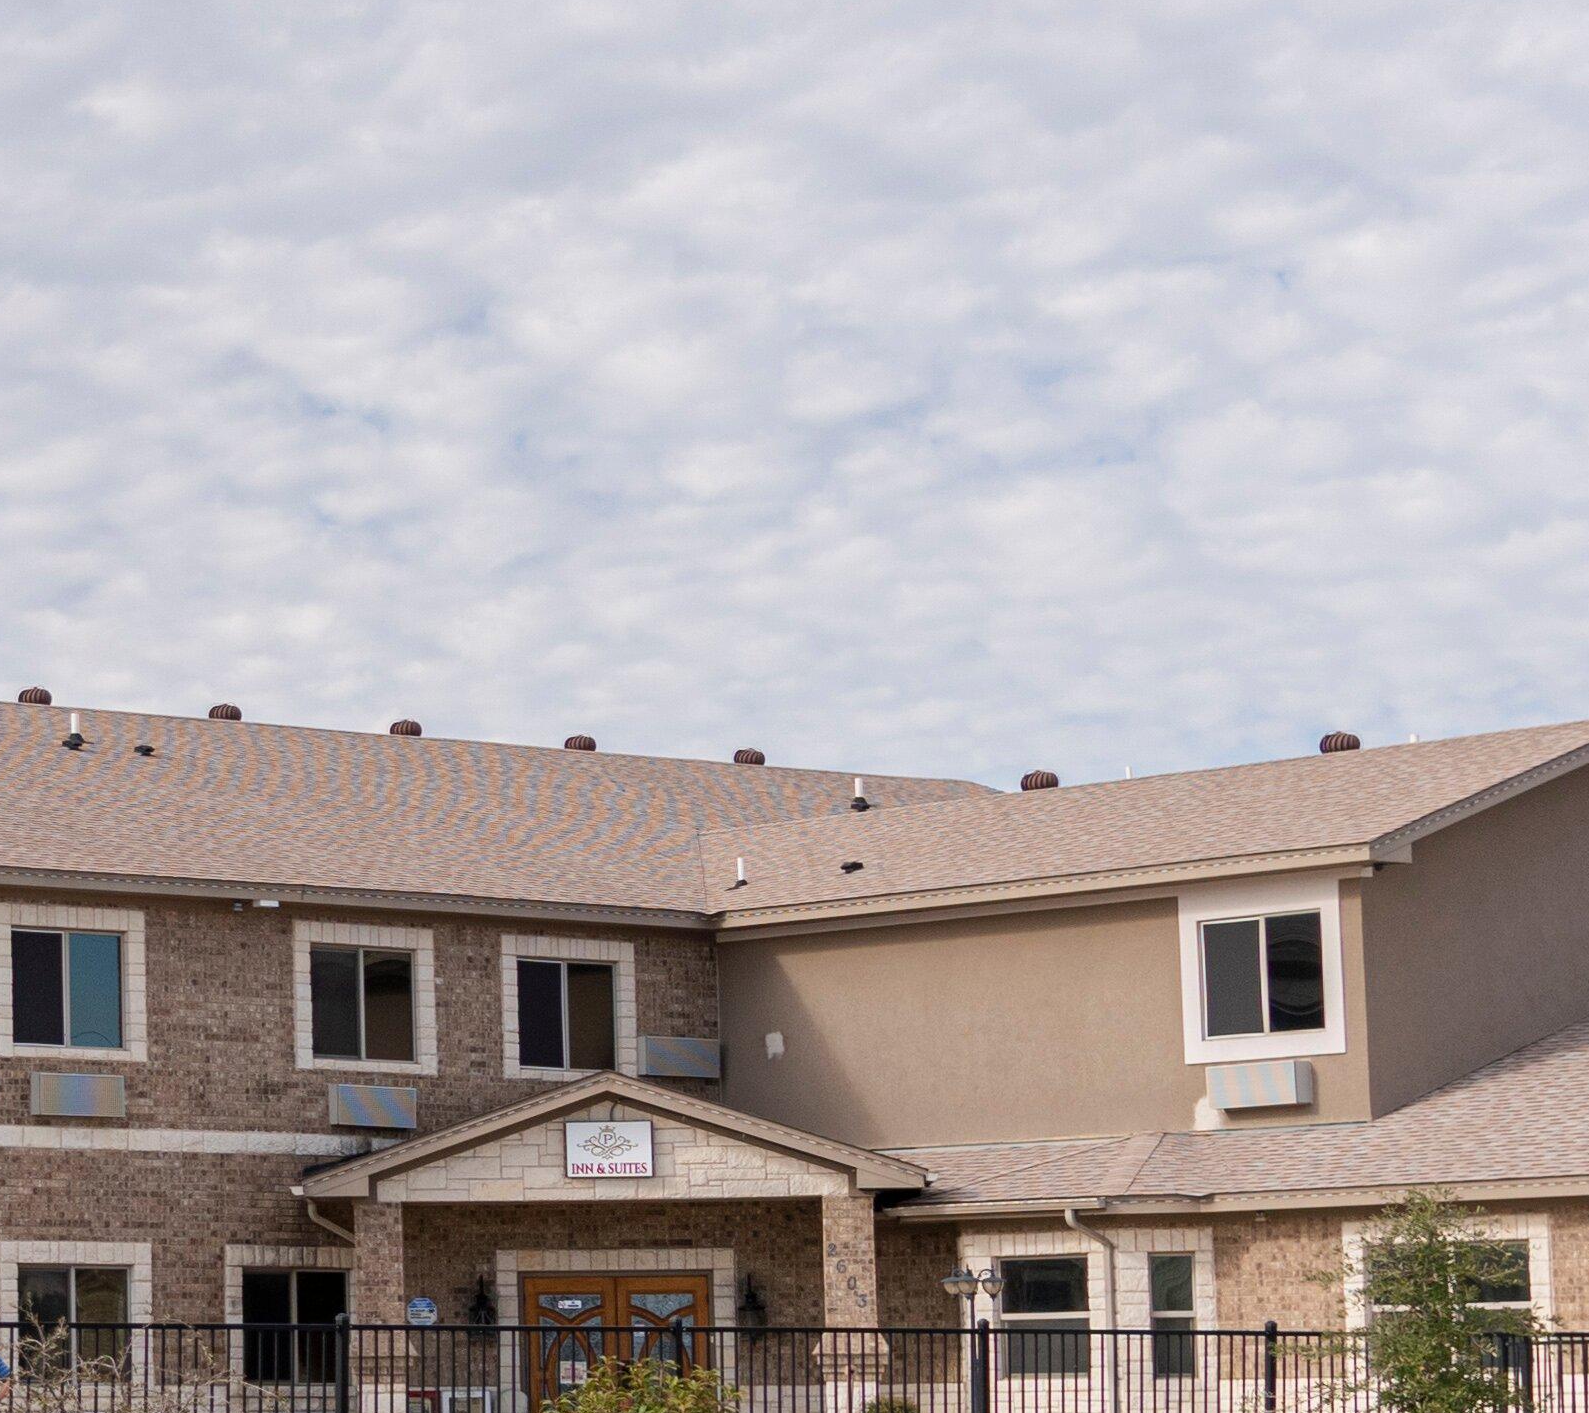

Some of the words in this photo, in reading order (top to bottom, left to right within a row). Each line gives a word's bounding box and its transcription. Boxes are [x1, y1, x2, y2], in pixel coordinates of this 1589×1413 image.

[603, 1133, 613, 1145] P
[571, 1162, 594, 1175] INN
[596, 1162, 606, 1175] &
[608, 1162, 648, 1175] SUITES
